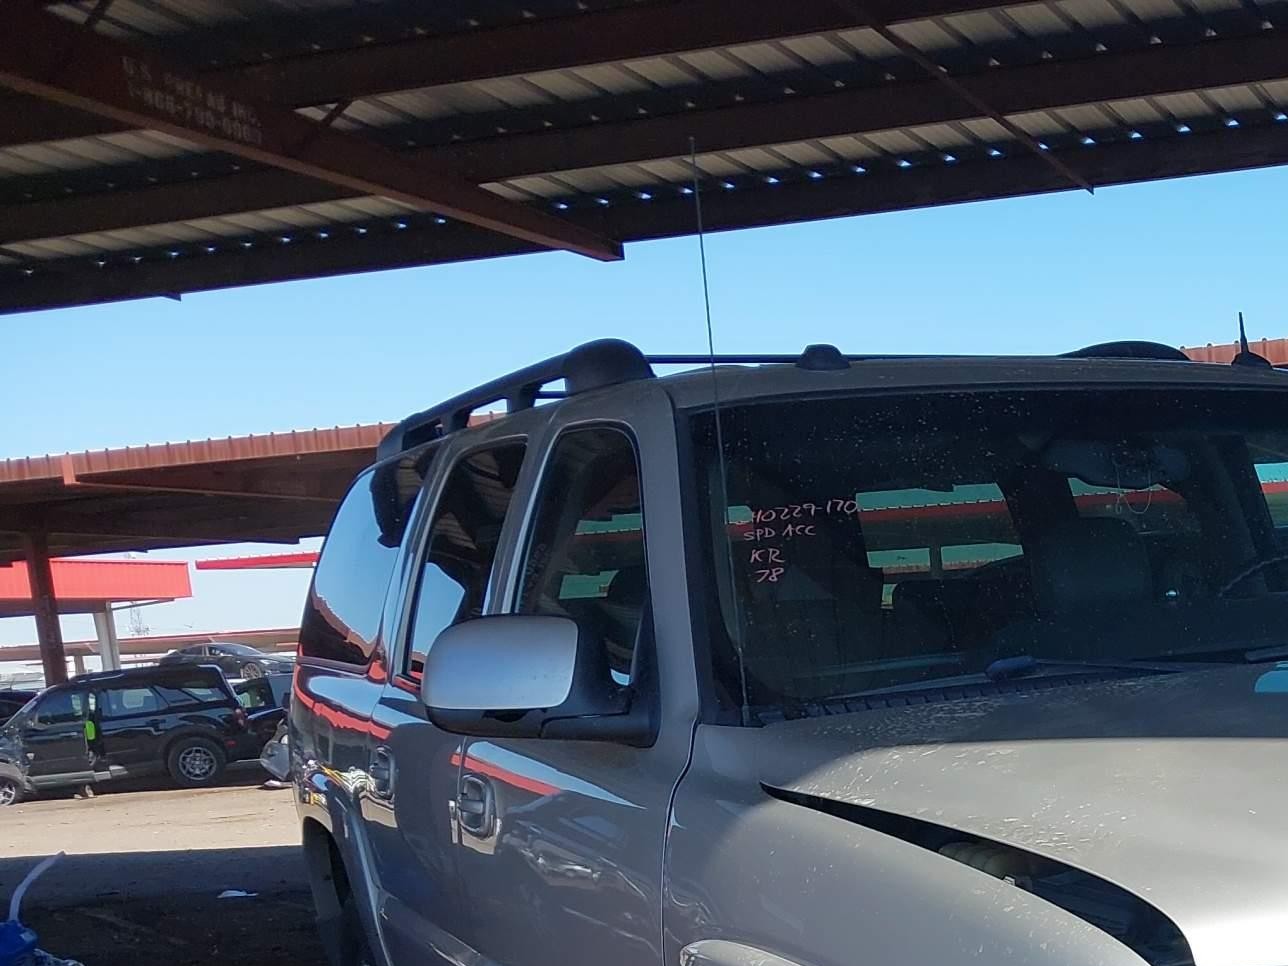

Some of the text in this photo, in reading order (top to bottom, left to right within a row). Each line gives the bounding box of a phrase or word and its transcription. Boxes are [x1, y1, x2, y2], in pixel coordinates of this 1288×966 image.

[744, 523, 817, 541] SPD ACC
[755, 567, 785, 583] 78
